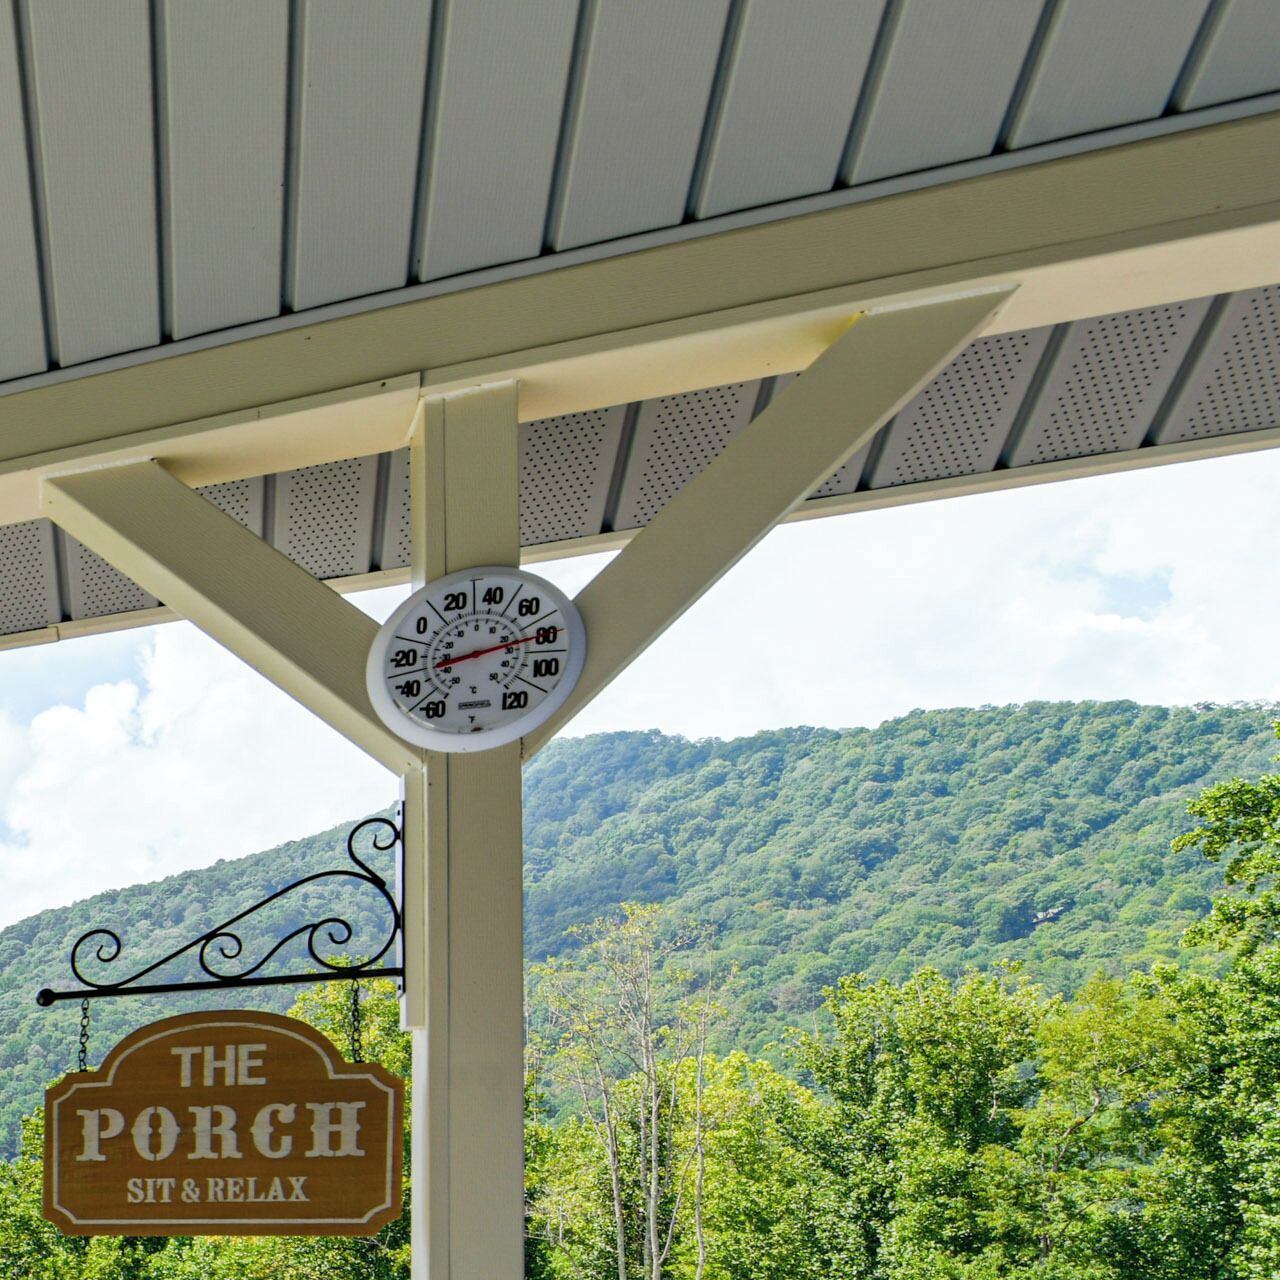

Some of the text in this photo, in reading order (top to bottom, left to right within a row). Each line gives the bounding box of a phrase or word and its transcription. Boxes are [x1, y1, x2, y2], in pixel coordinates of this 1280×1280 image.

[443, 591, 467, 611] 20
[482, 586, 504, 605] 40
[518, 597, 540, 617] 60
[416, 616, 428, 635] 0
[535, 625, 557, 645] 80
[390, 649, 417, 668] -20
[532, 658, 559, 678] 100
[395, 679, 421, 698] -40
[419, 700, 446, 719] -60
[501, 691, 529, 711] 120
[170, 1043, 267, 1088] THE
[75, 1101, 367, 1162] PORCH
[127, 1176, 310, 1203] SIT & RELAX
